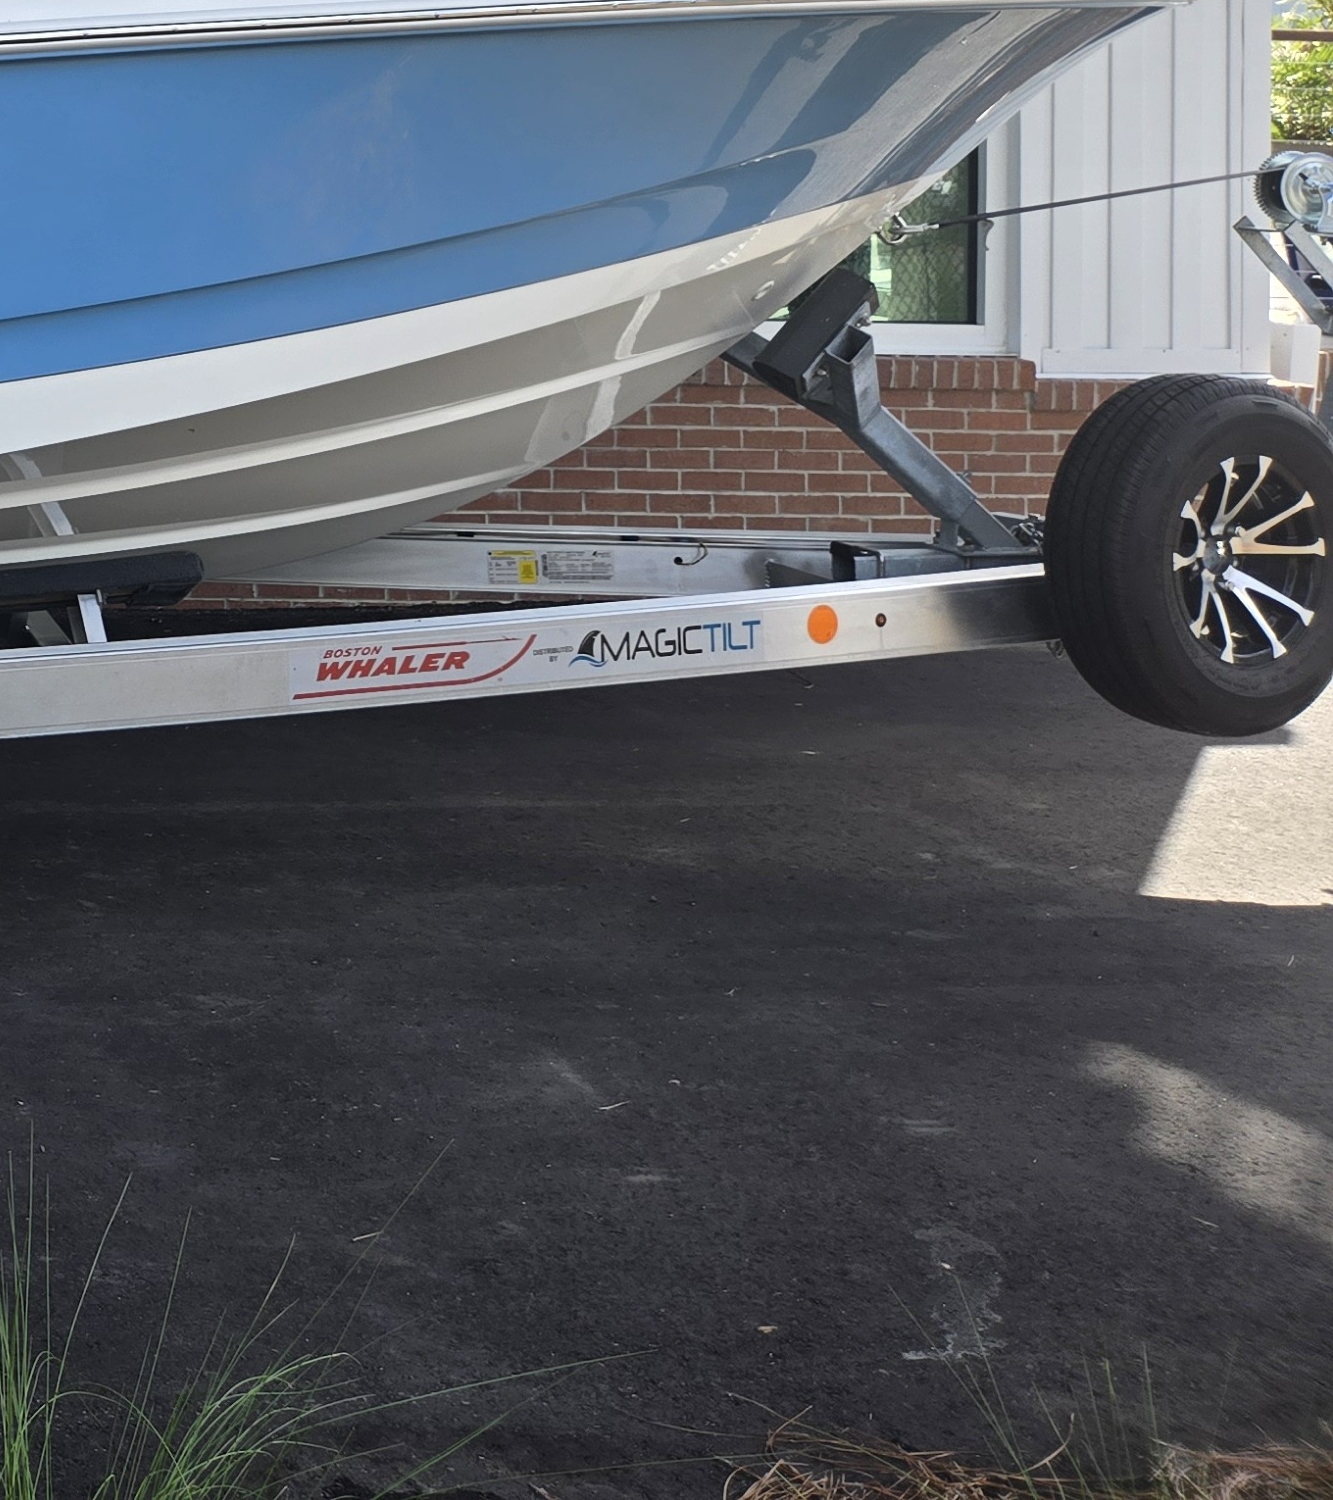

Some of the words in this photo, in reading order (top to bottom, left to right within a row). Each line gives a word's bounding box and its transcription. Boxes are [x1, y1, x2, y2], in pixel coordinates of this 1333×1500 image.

[322, 645, 382, 659] BOSTON
[600, 619, 761, 663] MAGICTILT
[316, 650, 471, 682] WHALER
